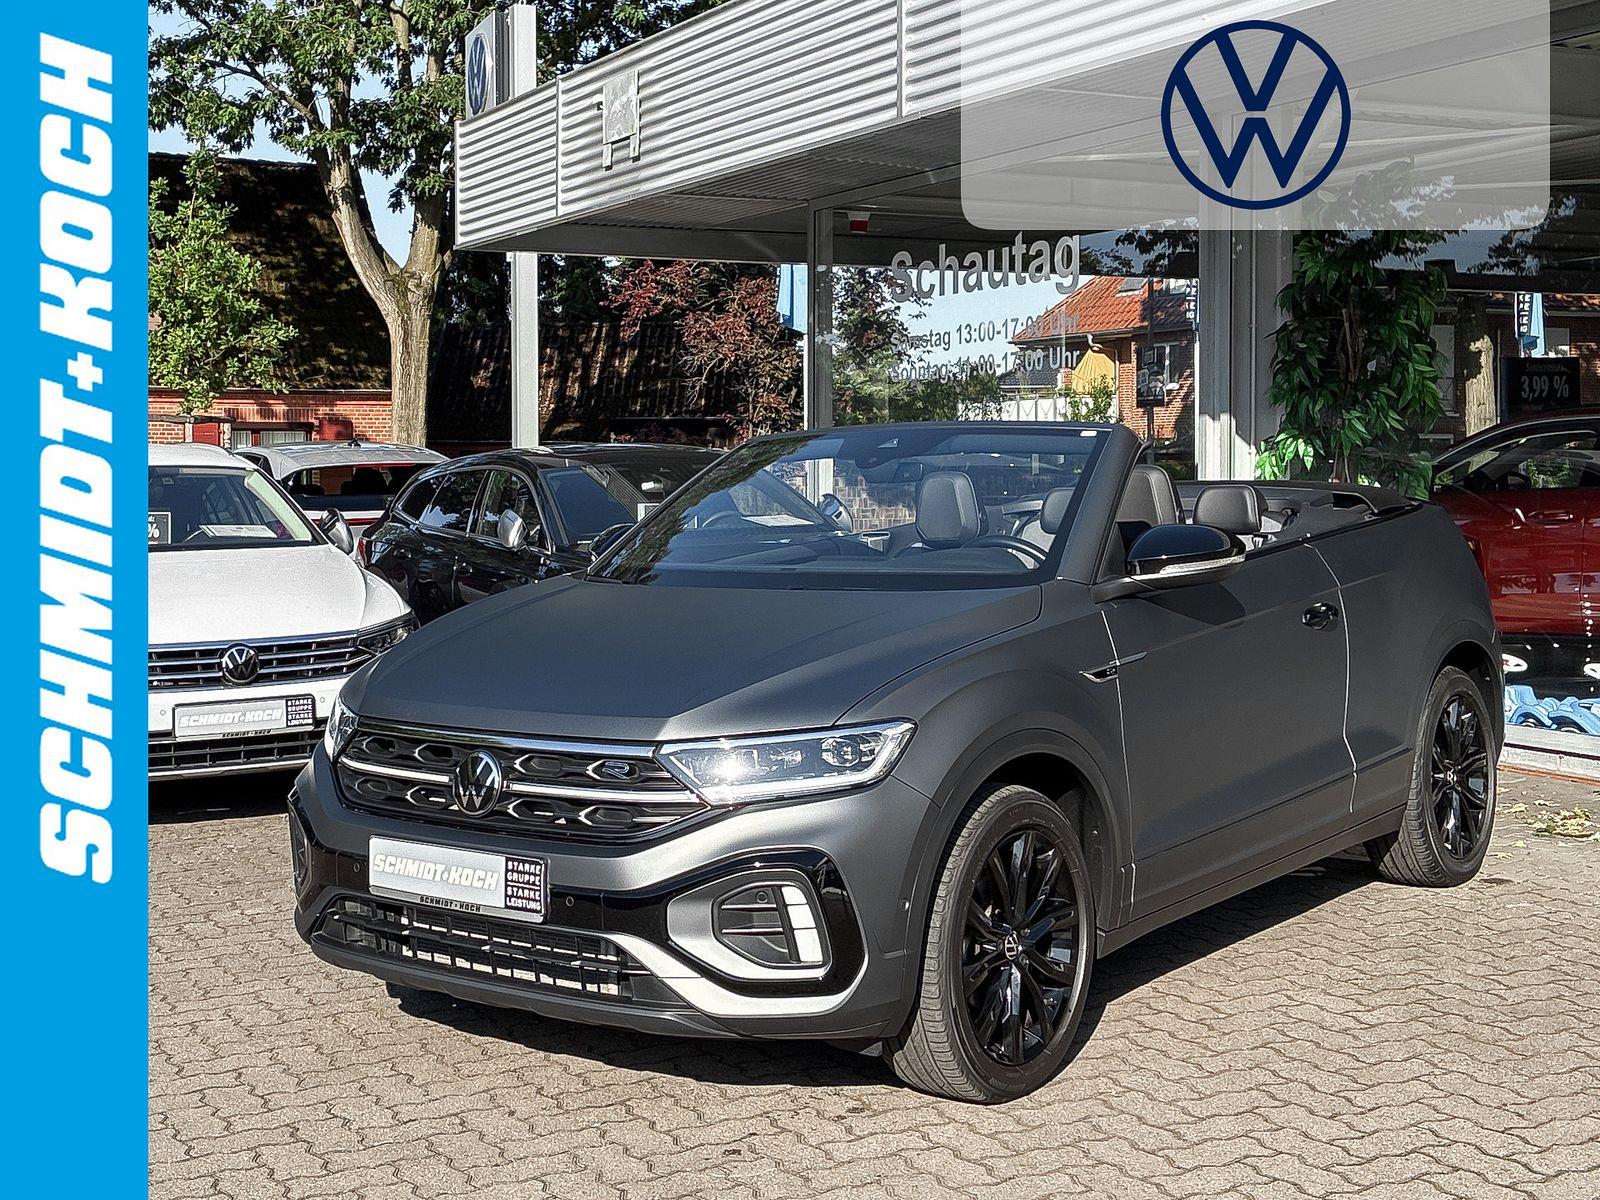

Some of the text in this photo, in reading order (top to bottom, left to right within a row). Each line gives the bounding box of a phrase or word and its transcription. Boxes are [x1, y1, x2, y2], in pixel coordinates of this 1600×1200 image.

[891, 230, 1080, 303] Schautag
[1050, 309, 1081, 335] Uhr
[889, 361, 949, 384] Sonntag
[1049, 346, 1080, 370] Uhr
[1521, 375, 1569, 402] 3,99 %
[373, 854, 499, 891] SCHMIDT+KOCH
[507, 860, 541, 875] STARKE
[507, 871, 541, 886] GRUPPE
[506, 896, 541, 911] LEISTUNG
[507, 886, 541, 900] STARKE
